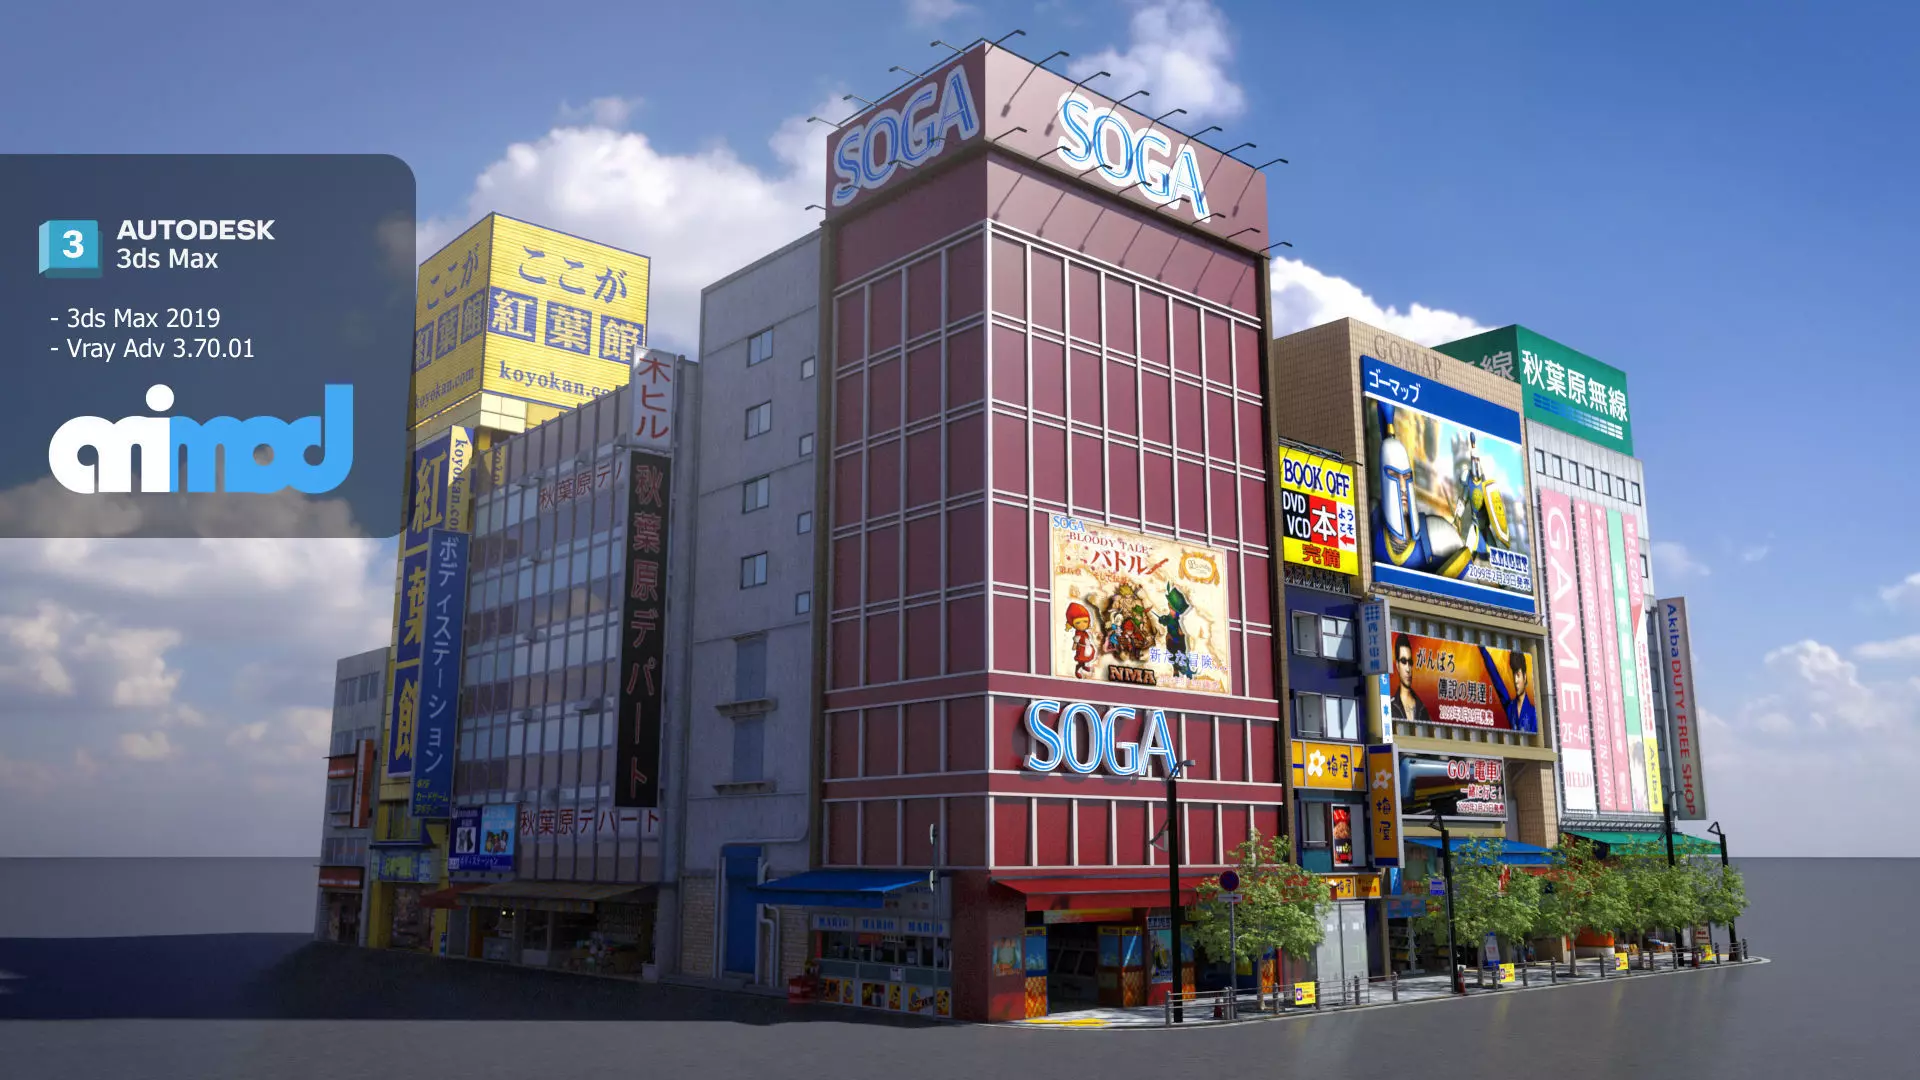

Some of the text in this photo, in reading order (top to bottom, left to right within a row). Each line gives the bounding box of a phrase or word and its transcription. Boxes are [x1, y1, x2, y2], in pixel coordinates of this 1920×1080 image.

[832, 64, 980, 206] SOGA
[1057, 91, 1212, 223] SOGA
[426, 242, 480, 311] ここが
[517, 244, 628, 305] ここが
[415, 299, 484, 369] 紅葉館
[490, 289, 641, 363] 紅葉館
[1373, 334, 1443, 380] GOMAP
[1467, 350, 1516, 381] 線
[499, 360, 611, 398] koyokan.co
[1521, 349, 1628, 423] 秋葉原無線
[1283, 457, 1350, 497] BOOK OFF
[1282, 490, 1306, 514] DVD
[1312, 504, 1337, 542] 本
[1053, 515, 1085, 532] SOGA
[1069, 531, 1115, 548] BLOODY
[1286, 514, 1311, 539] VCD
[1302, 543, 1341, 569] 完備
[1489, 547, 1529, 573] KNIGHT
[1547, 506, 1584, 713] GAME
[1667, 603, 1680, 658] Akiba
[627, 464, 665, 800] 秋葉原デパート
[424, 536, 460, 773] ボディステーション
[1416, 648, 1456, 673] がんばろ
[1588, 629, 1601, 678] GAMES
[1108, 665, 1157, 685] NMA
[1024, 700, 1181, 777] SOGA
[1561, 722, 1590, 744] 2F-4F
[1595, 697, 1607, 742] PRIZES
[1671, 660, 1697, 816] DUTY FREE SHOP
[1448, 760, 1470, 779] GO!
[1600, 744, 1608, 760] IN
[1565, 771, 1592, 788] HELLO
[1601, 763, 1613, 807] JAPAN
[862, 918, 894, 930] MARIO
